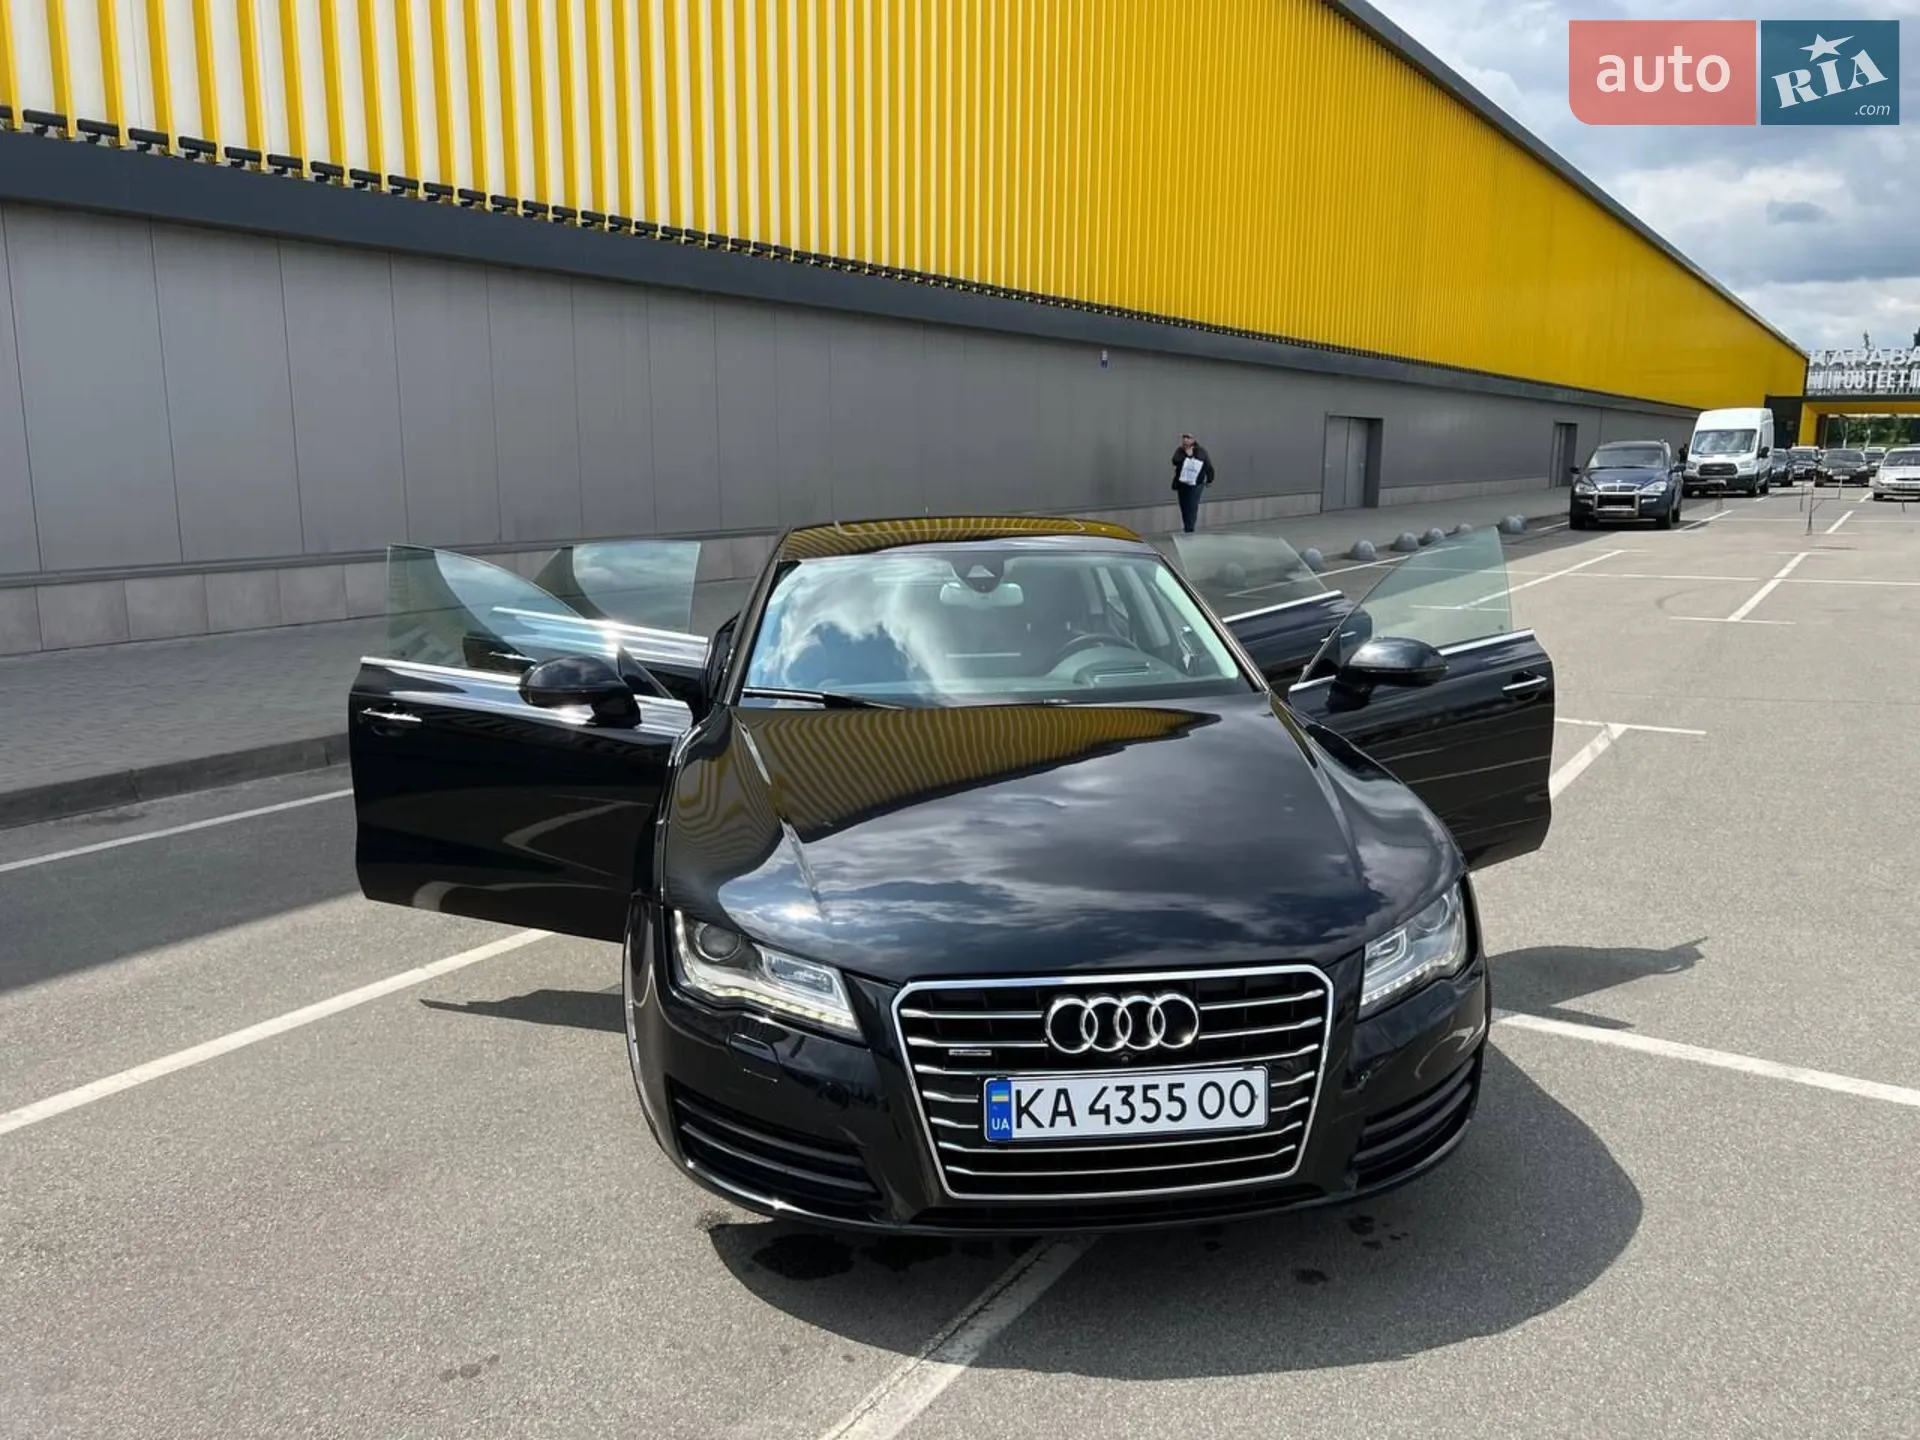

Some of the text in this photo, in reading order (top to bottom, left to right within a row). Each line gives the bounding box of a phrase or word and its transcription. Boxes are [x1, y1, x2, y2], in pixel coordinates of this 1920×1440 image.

[1015, 1087, 1077, 1129] KA
[1088, 1083, 1187, 1126] 4355
[991, 1117, 1010, 1130] UA
